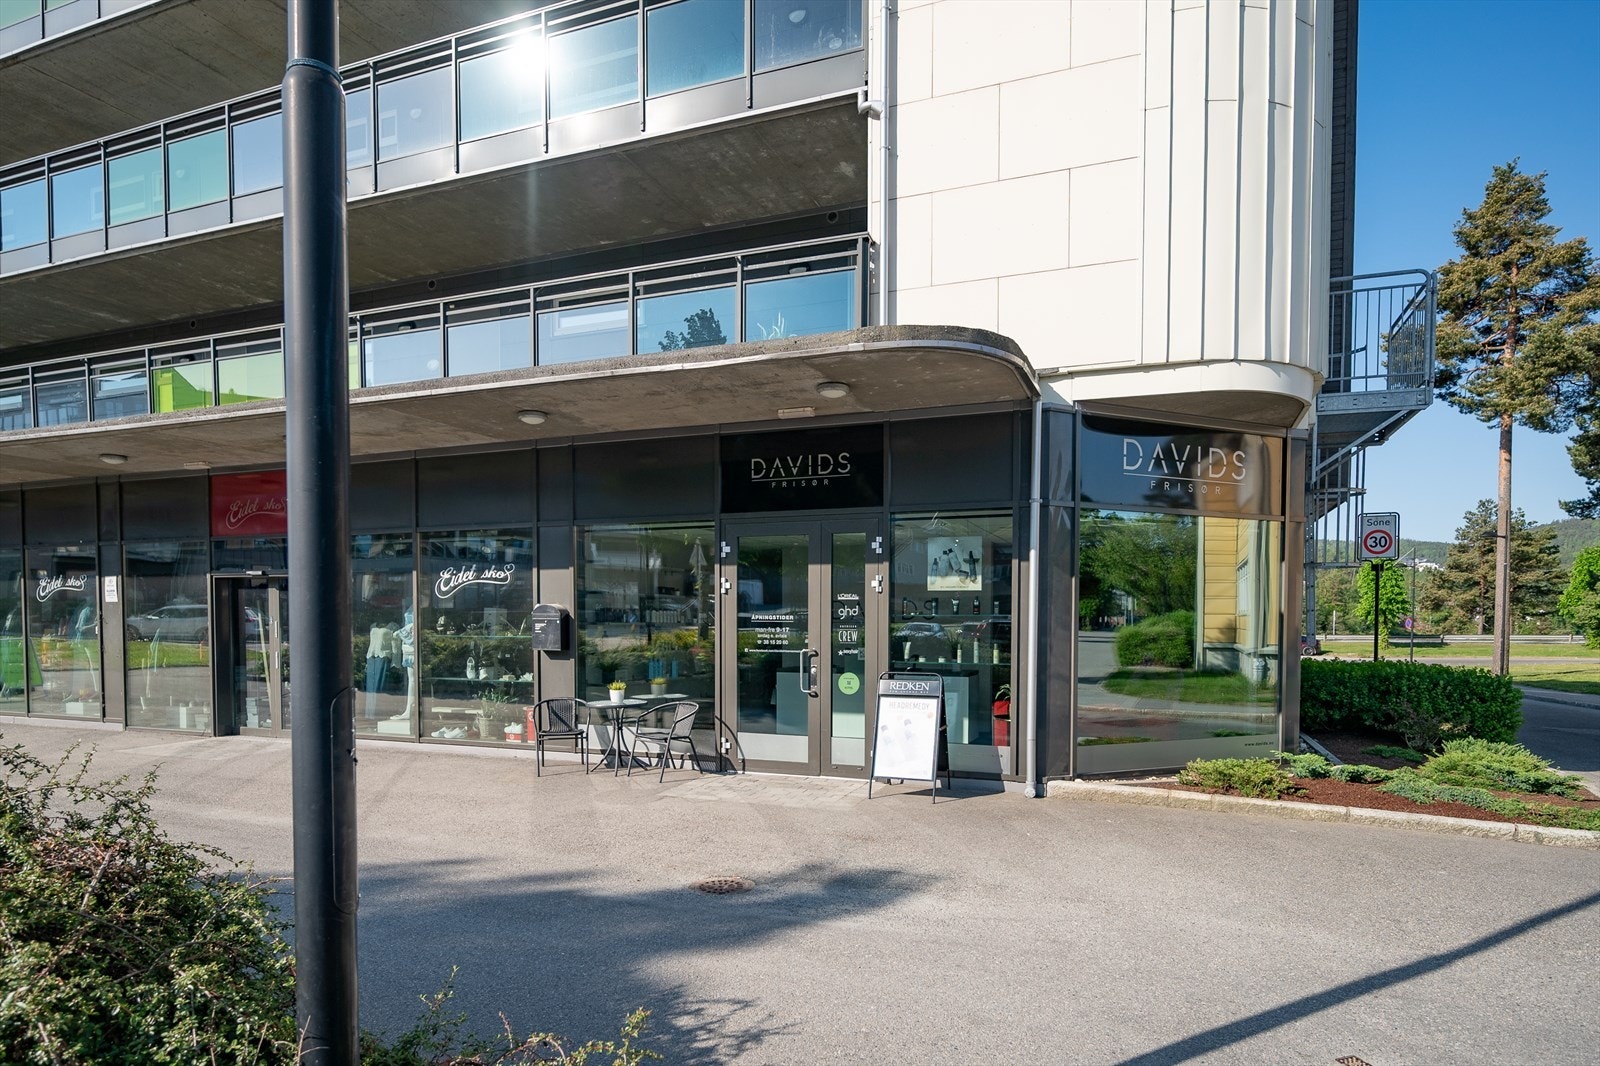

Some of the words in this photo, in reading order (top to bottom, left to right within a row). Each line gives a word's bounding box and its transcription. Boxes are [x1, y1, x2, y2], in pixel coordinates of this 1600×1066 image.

[751, 452, 851, 479] DAVIDS
[1123, 438, 1246, 481] DAVIDS
[771, 478, 830, 489] FRISØR
[1150, 480, 1222, 495] FRISØR
[1366, 518, 1391, 527] Sone
[1368, 536, 1388, 548] 30
[437, 563, 478, 594] Eidet
[480, 563, 508, 580] sko
[38, 574, 64, 598] Eidet
[65, 575, 82, 588] sko
[751, 613, 794, 621] ÅPNINGSTIDER
[838, 605, 859, 620] ghd
[838, 630, 858, 642] CREW
[889, 681, 930, 691] REDKEN
